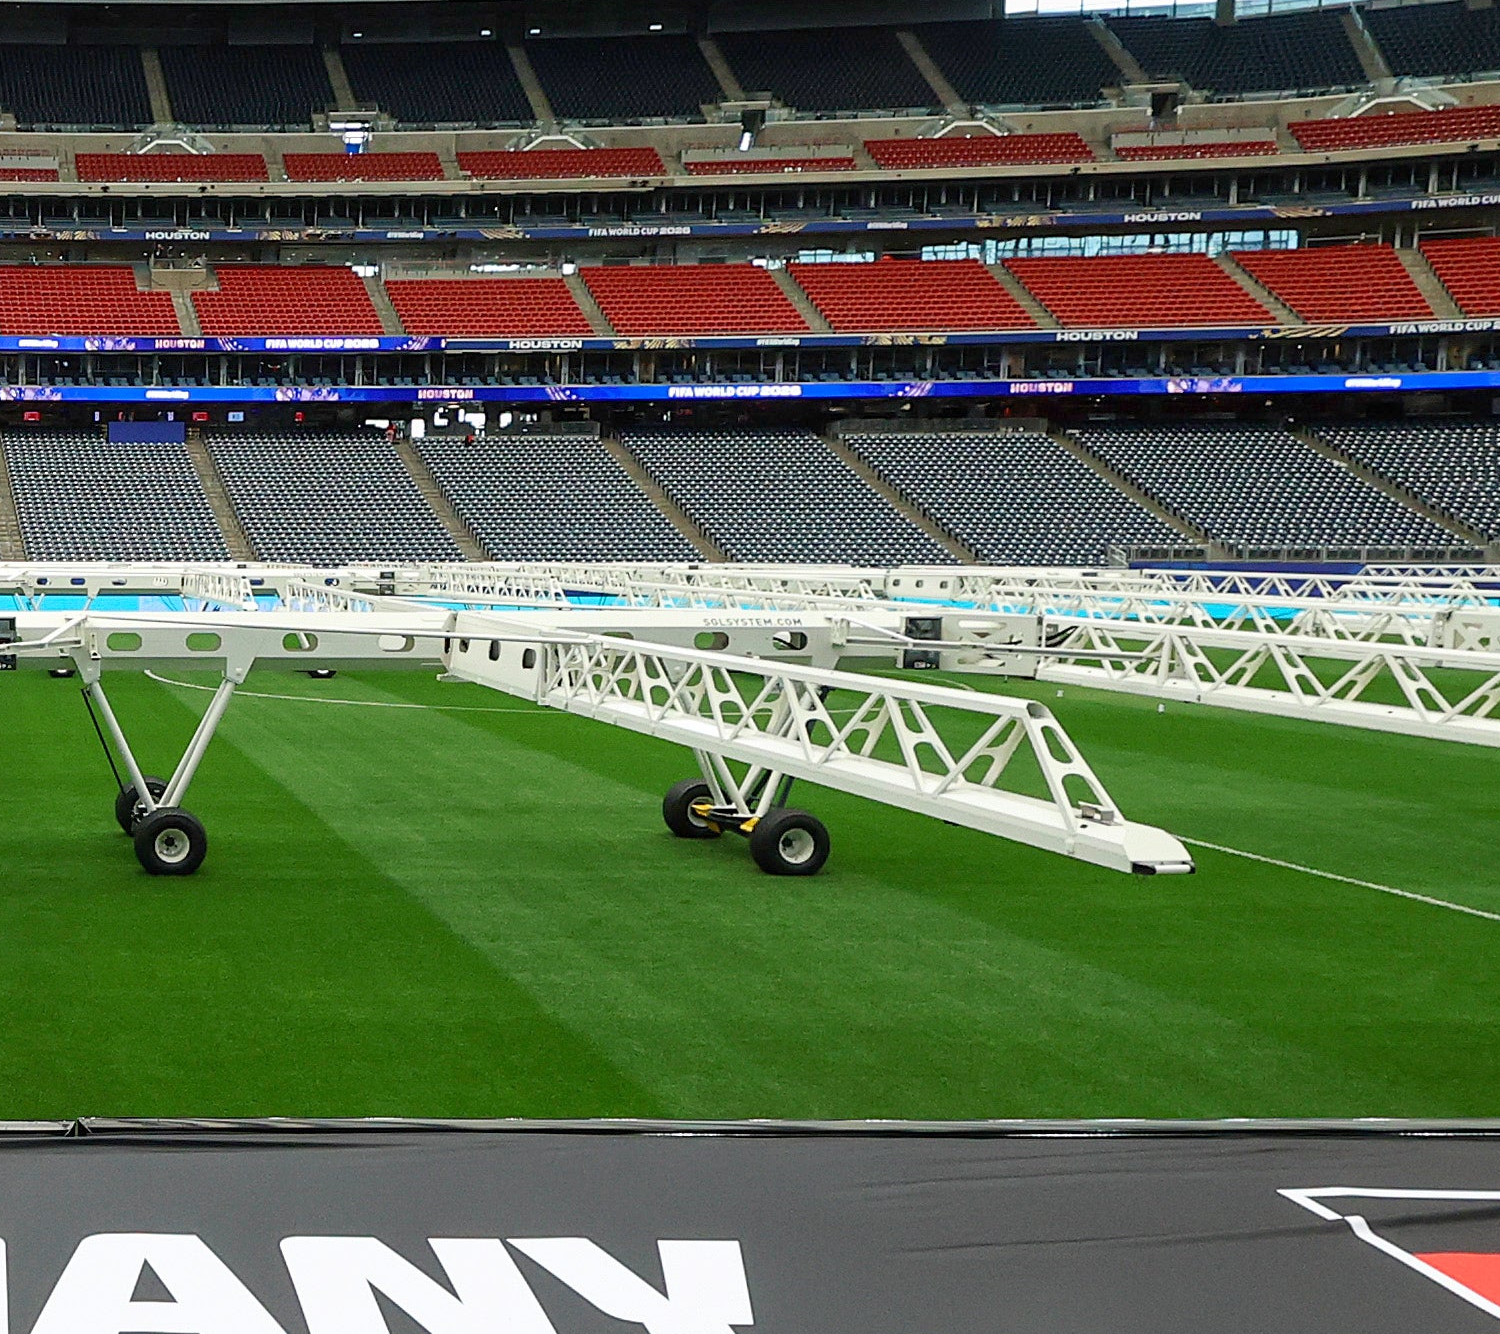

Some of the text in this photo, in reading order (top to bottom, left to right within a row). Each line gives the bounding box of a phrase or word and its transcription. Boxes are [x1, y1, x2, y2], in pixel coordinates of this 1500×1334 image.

[1411, 199, 1437, 209] FIFA
[1438, 197, 1480, 207] WORLD
[1124, 212, 1201, 222] HOUSTON
[145, 231, 210, 240] HOUSTON
[588, 228, 608, 237] FIFA
[608, 227, 640, 236] WORLD
[640, 227, 659, 235] CUP
[1390, 325, 1417, 334] FIFA
[1417, 323, 1463, 333] WORLD
[1465, 321, 1492, 331] CUP
[1056, 331, 1138, 341] HOUSTON
[154, 339, 205, 349] HOUSTON
[266, 339, 287, 349] FIFA
[287, 339, 323, 349] WORLD
[324, 339, 343, 349] CUP
[509, 340, 582, 349] HOUSTON
[668, 387, 694, 397] FIFA
[694, 386, 735, 397] WORLD
[736, 386, 759, 397] CUP
[1010, 383, 1073, 393] HOUSTON
[418, 389, 474, 399] HOUSTON
